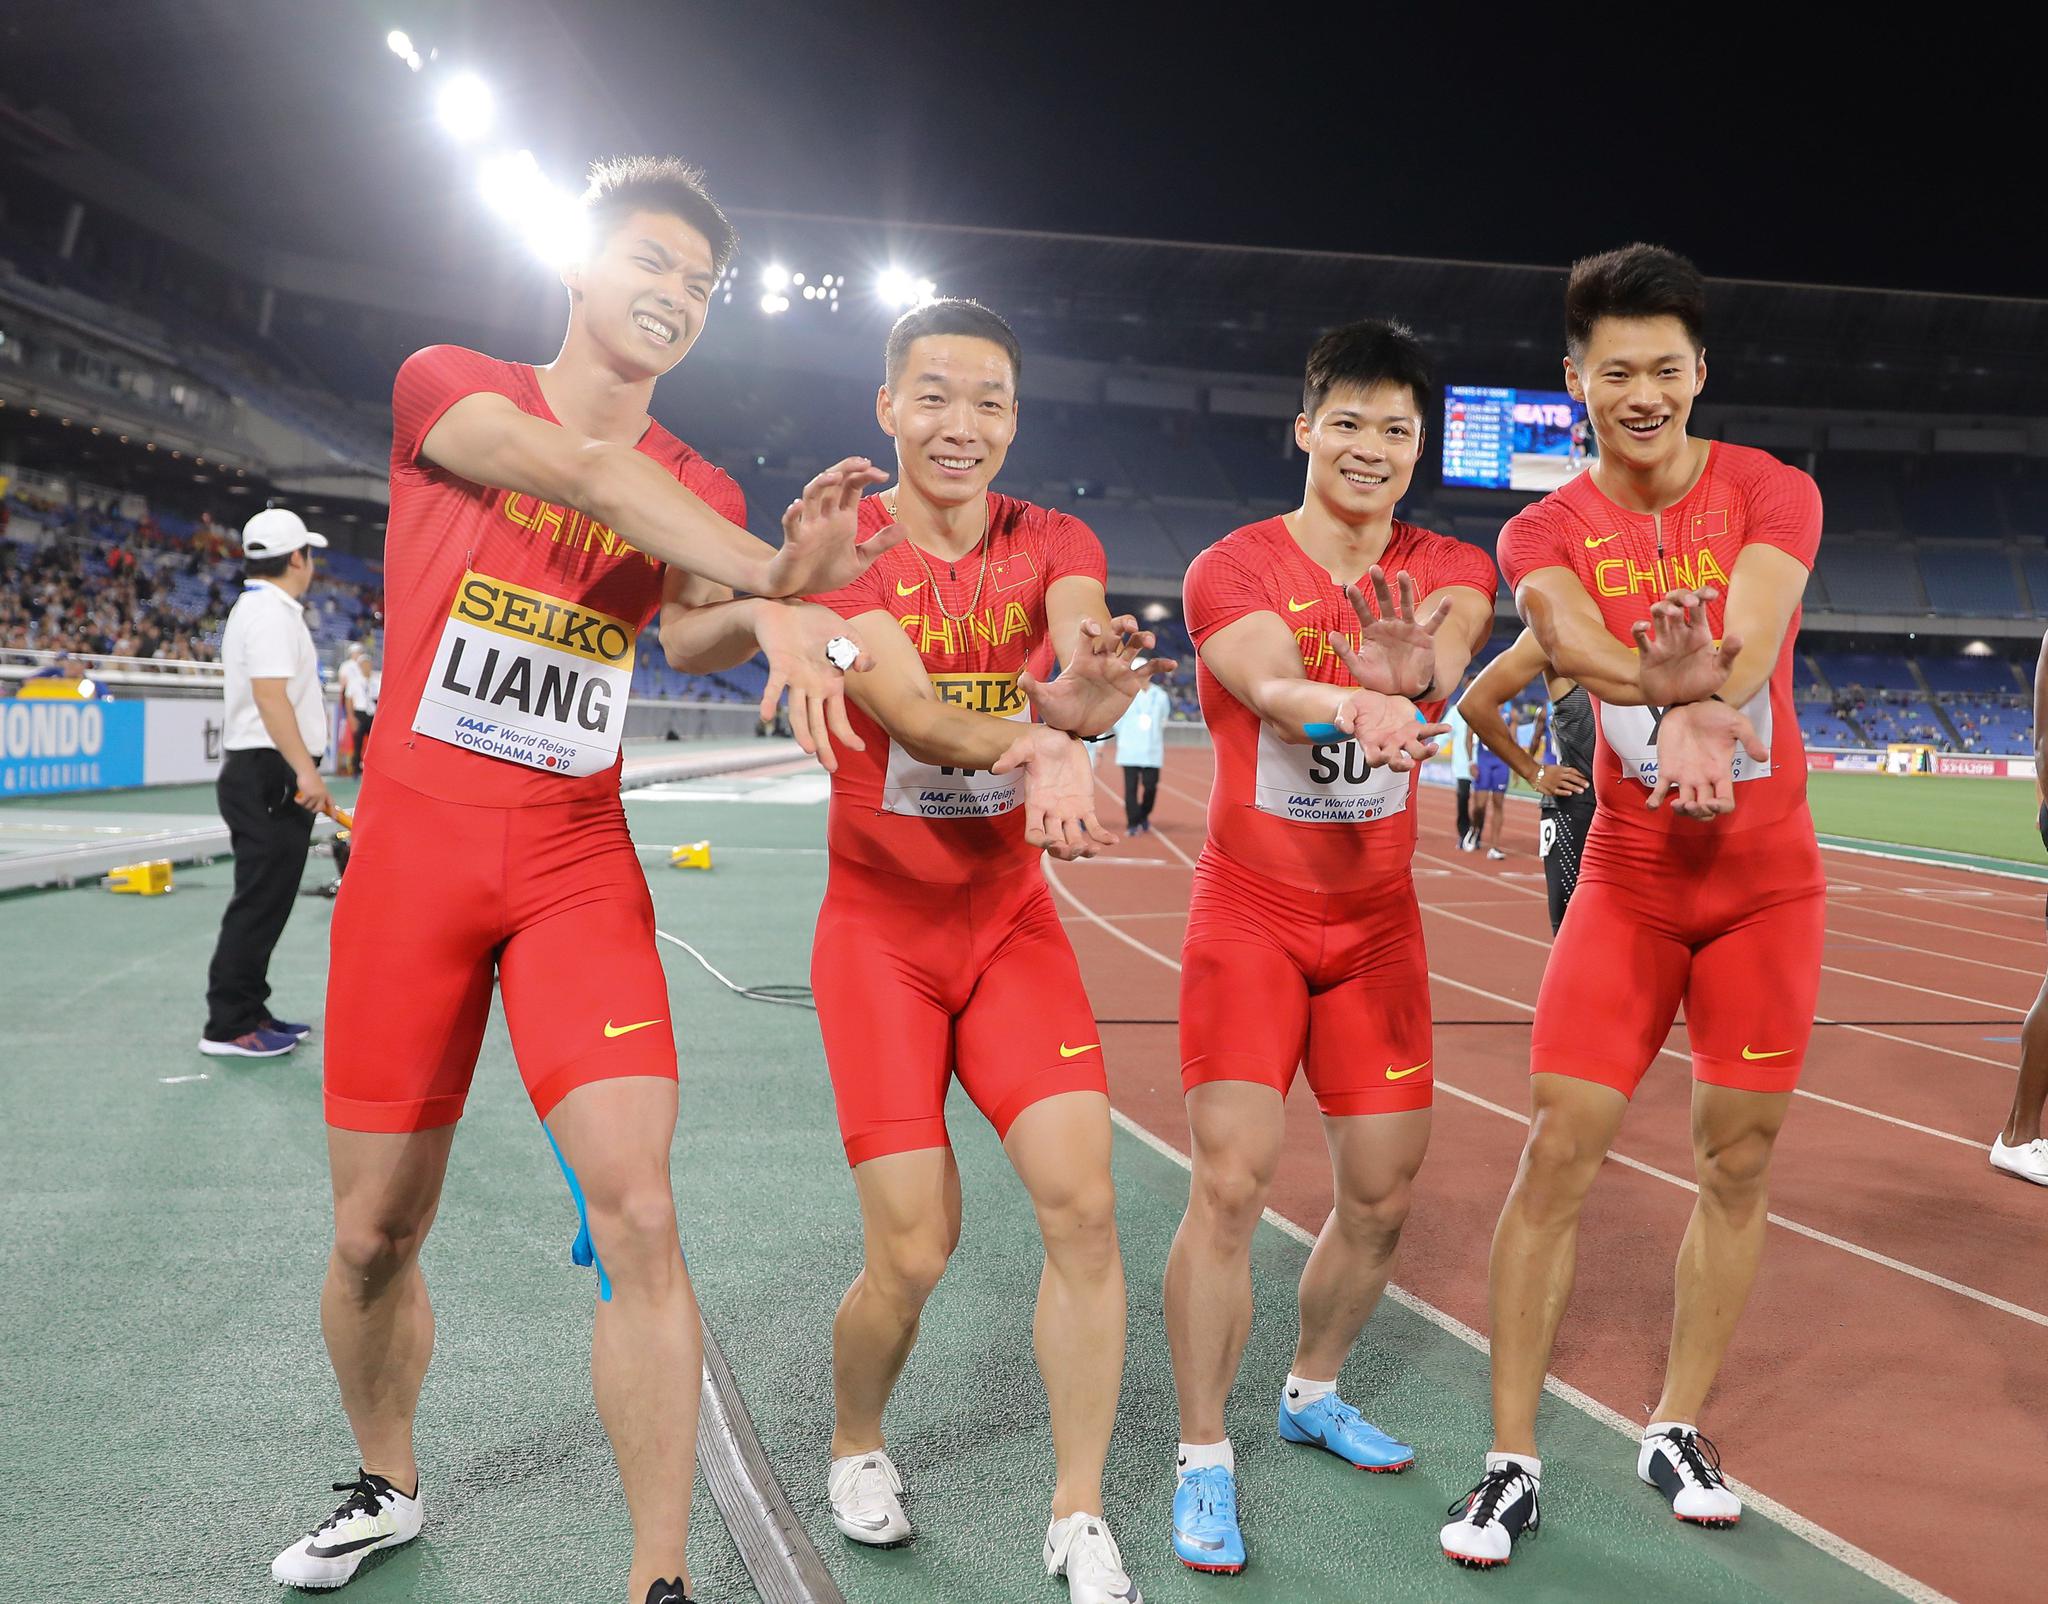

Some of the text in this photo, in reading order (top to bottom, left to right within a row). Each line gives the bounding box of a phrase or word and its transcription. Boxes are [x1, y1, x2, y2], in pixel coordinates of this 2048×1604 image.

[1595, 548, 1730, 597] CHINA
[458, 580, 629, 661] SEIKO
[1294, 626, 1363, 668] CHI
[441, 636, 612, 733] LIANG
[931, 680, 1027, 713] EIK
[454, 730, 534, 763] YOKOHAMA
[456, 715, 577, 758] IAAF World Relays
[1309, 741, 1372, 785] SU
[919, 788, 1017, 803] IAAF World Relays
[919, 803, 990, 816] YOKOHAMA
[1287, 795, 1385, 808] IAAF World Relays
[1287, 808, 1356, 820] YOKOHAMA
[1544, 825, 1552, 846] 9
